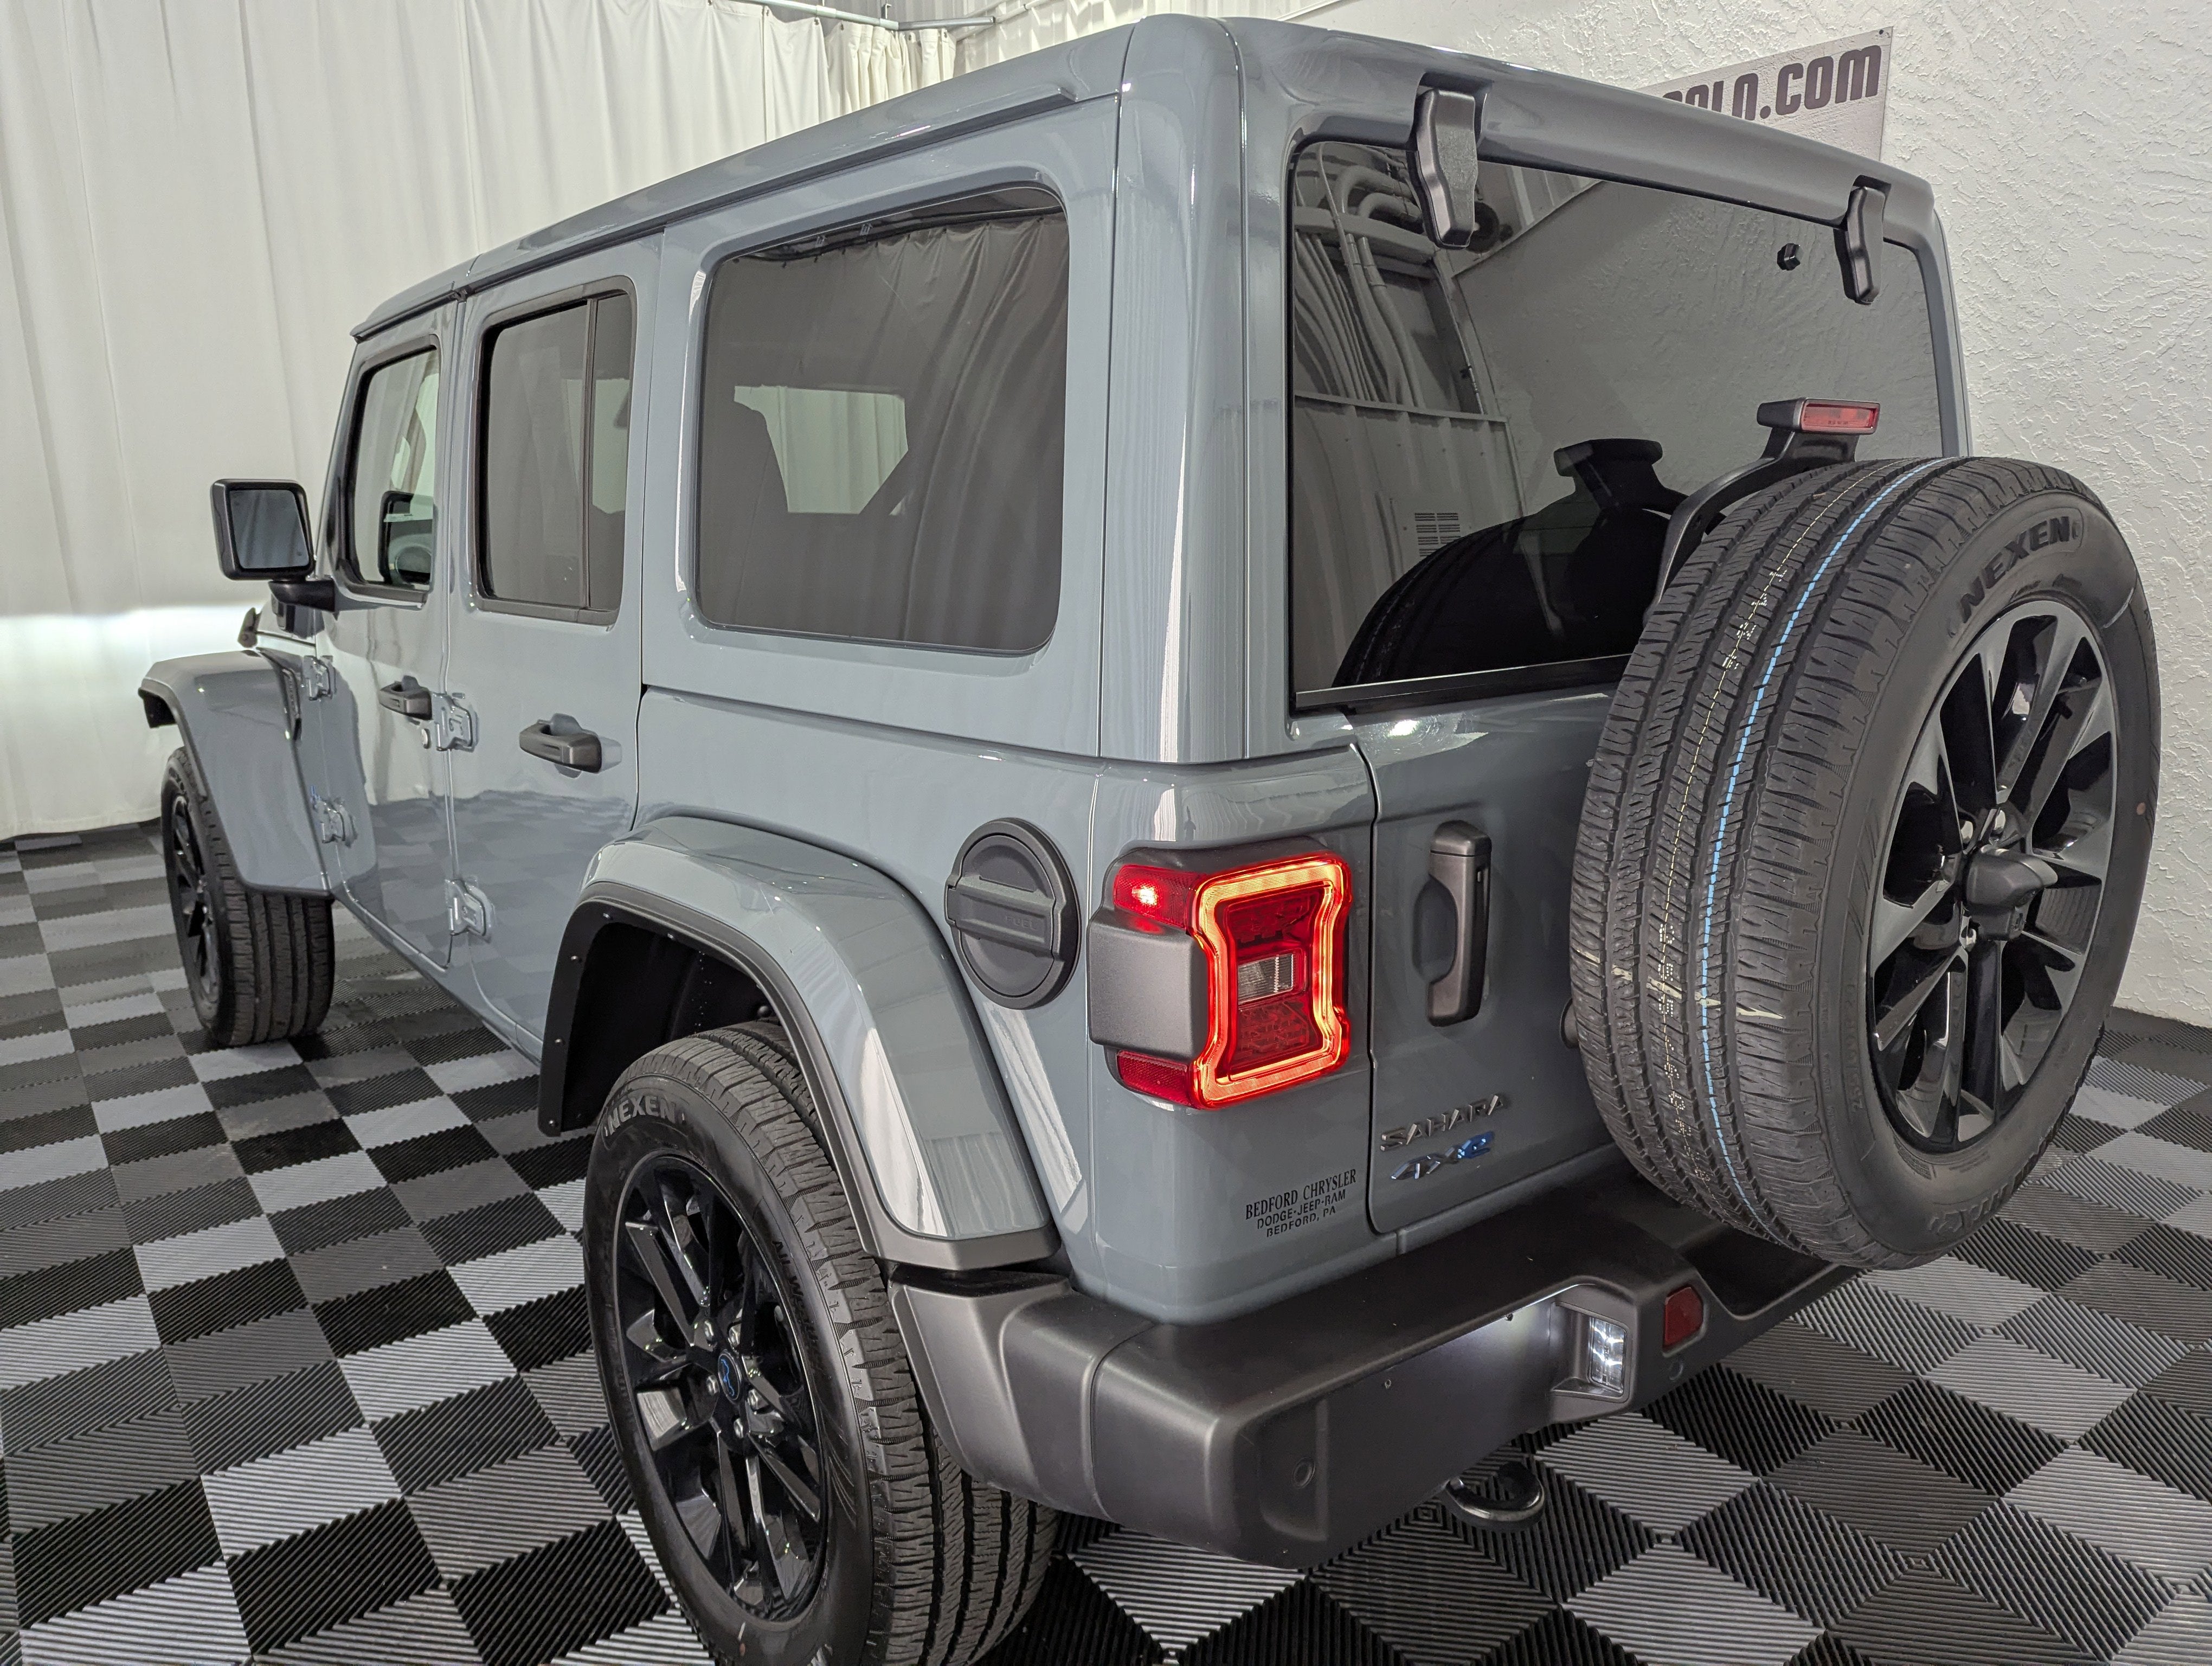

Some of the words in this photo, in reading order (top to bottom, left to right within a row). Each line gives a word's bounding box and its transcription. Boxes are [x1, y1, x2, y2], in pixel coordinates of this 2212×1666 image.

[1959, 516, 2070, 624] NEXEN
[1005, 915, 1038, 931] FUEL
[607, 1094, 677, 1137] NEXEN
[1380, 1094, 1504, 1152] SAHARA
[1245, 1189, 1298, 1220] BEDFORD
[1303, 1168, 1356, 1200] CHRYSLER
[1266, 1213, 1320, 1238] BEDFORD,
[1323, 1205, 1336, 1218] PA
